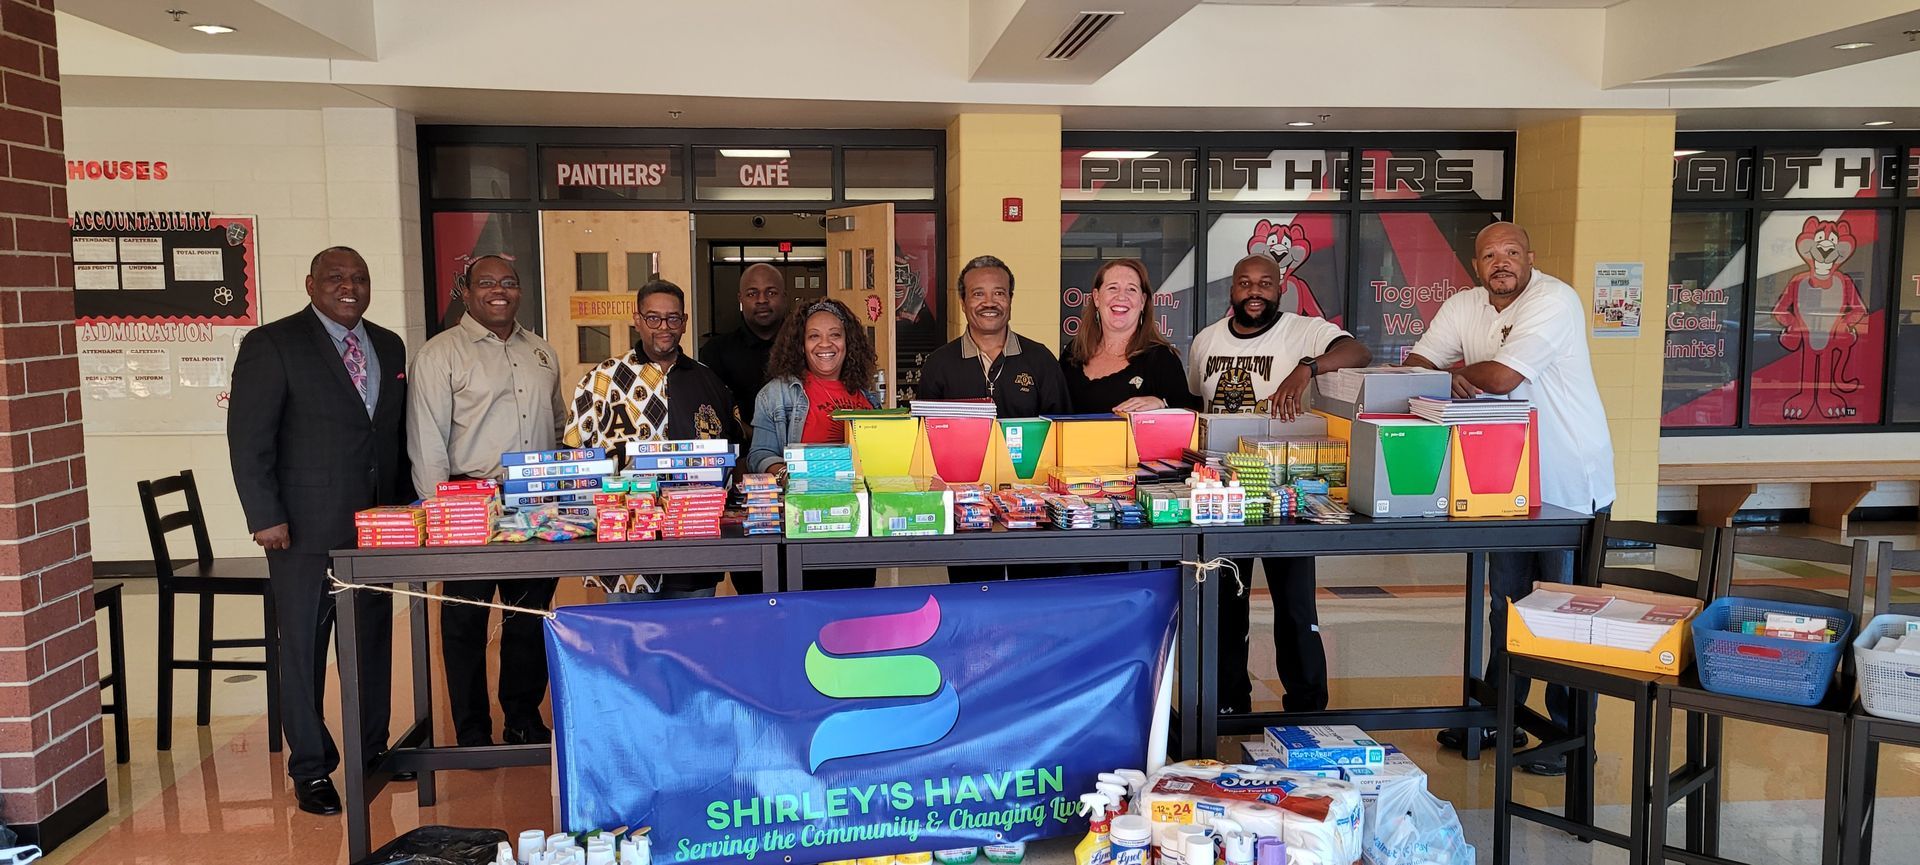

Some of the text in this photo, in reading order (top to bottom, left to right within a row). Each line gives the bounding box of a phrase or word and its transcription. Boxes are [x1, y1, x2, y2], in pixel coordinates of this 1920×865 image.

[67, 160, 168, 181] HOUSES
[557, 159, 789, 186] PANTHERS' CAFÉ
[1080, 158, 1474, 193] PANTHERS
[1674, 155, 1920, 192] ANTHE
[73, 210, 212, 231] ACCOUNTABILITY
[1669, 284, 1729, 304] Team,
[592, 301, 637, 315] RESPECTFU
[1384, 313, 1425, 335] We
[1668, 311, 1722, 332] Goal,
[82, 322, 214, 343] ADMIRATION
[1664, 339, 1724, 358] imits!
[1204, 355, 1274, 382] SOUTH FULTON
[1846, 408, 1856, 416] TM
[706, 766, 1063, 830] SHIRLEY'S HAVEN
[1157, 805, 1166, 813] 12
[1173, 803, 1191, 816] 24
[675, 797, 1083, 861] Serving the Community & Changing Live
[1118, 850, 1141, 865] Lysol
